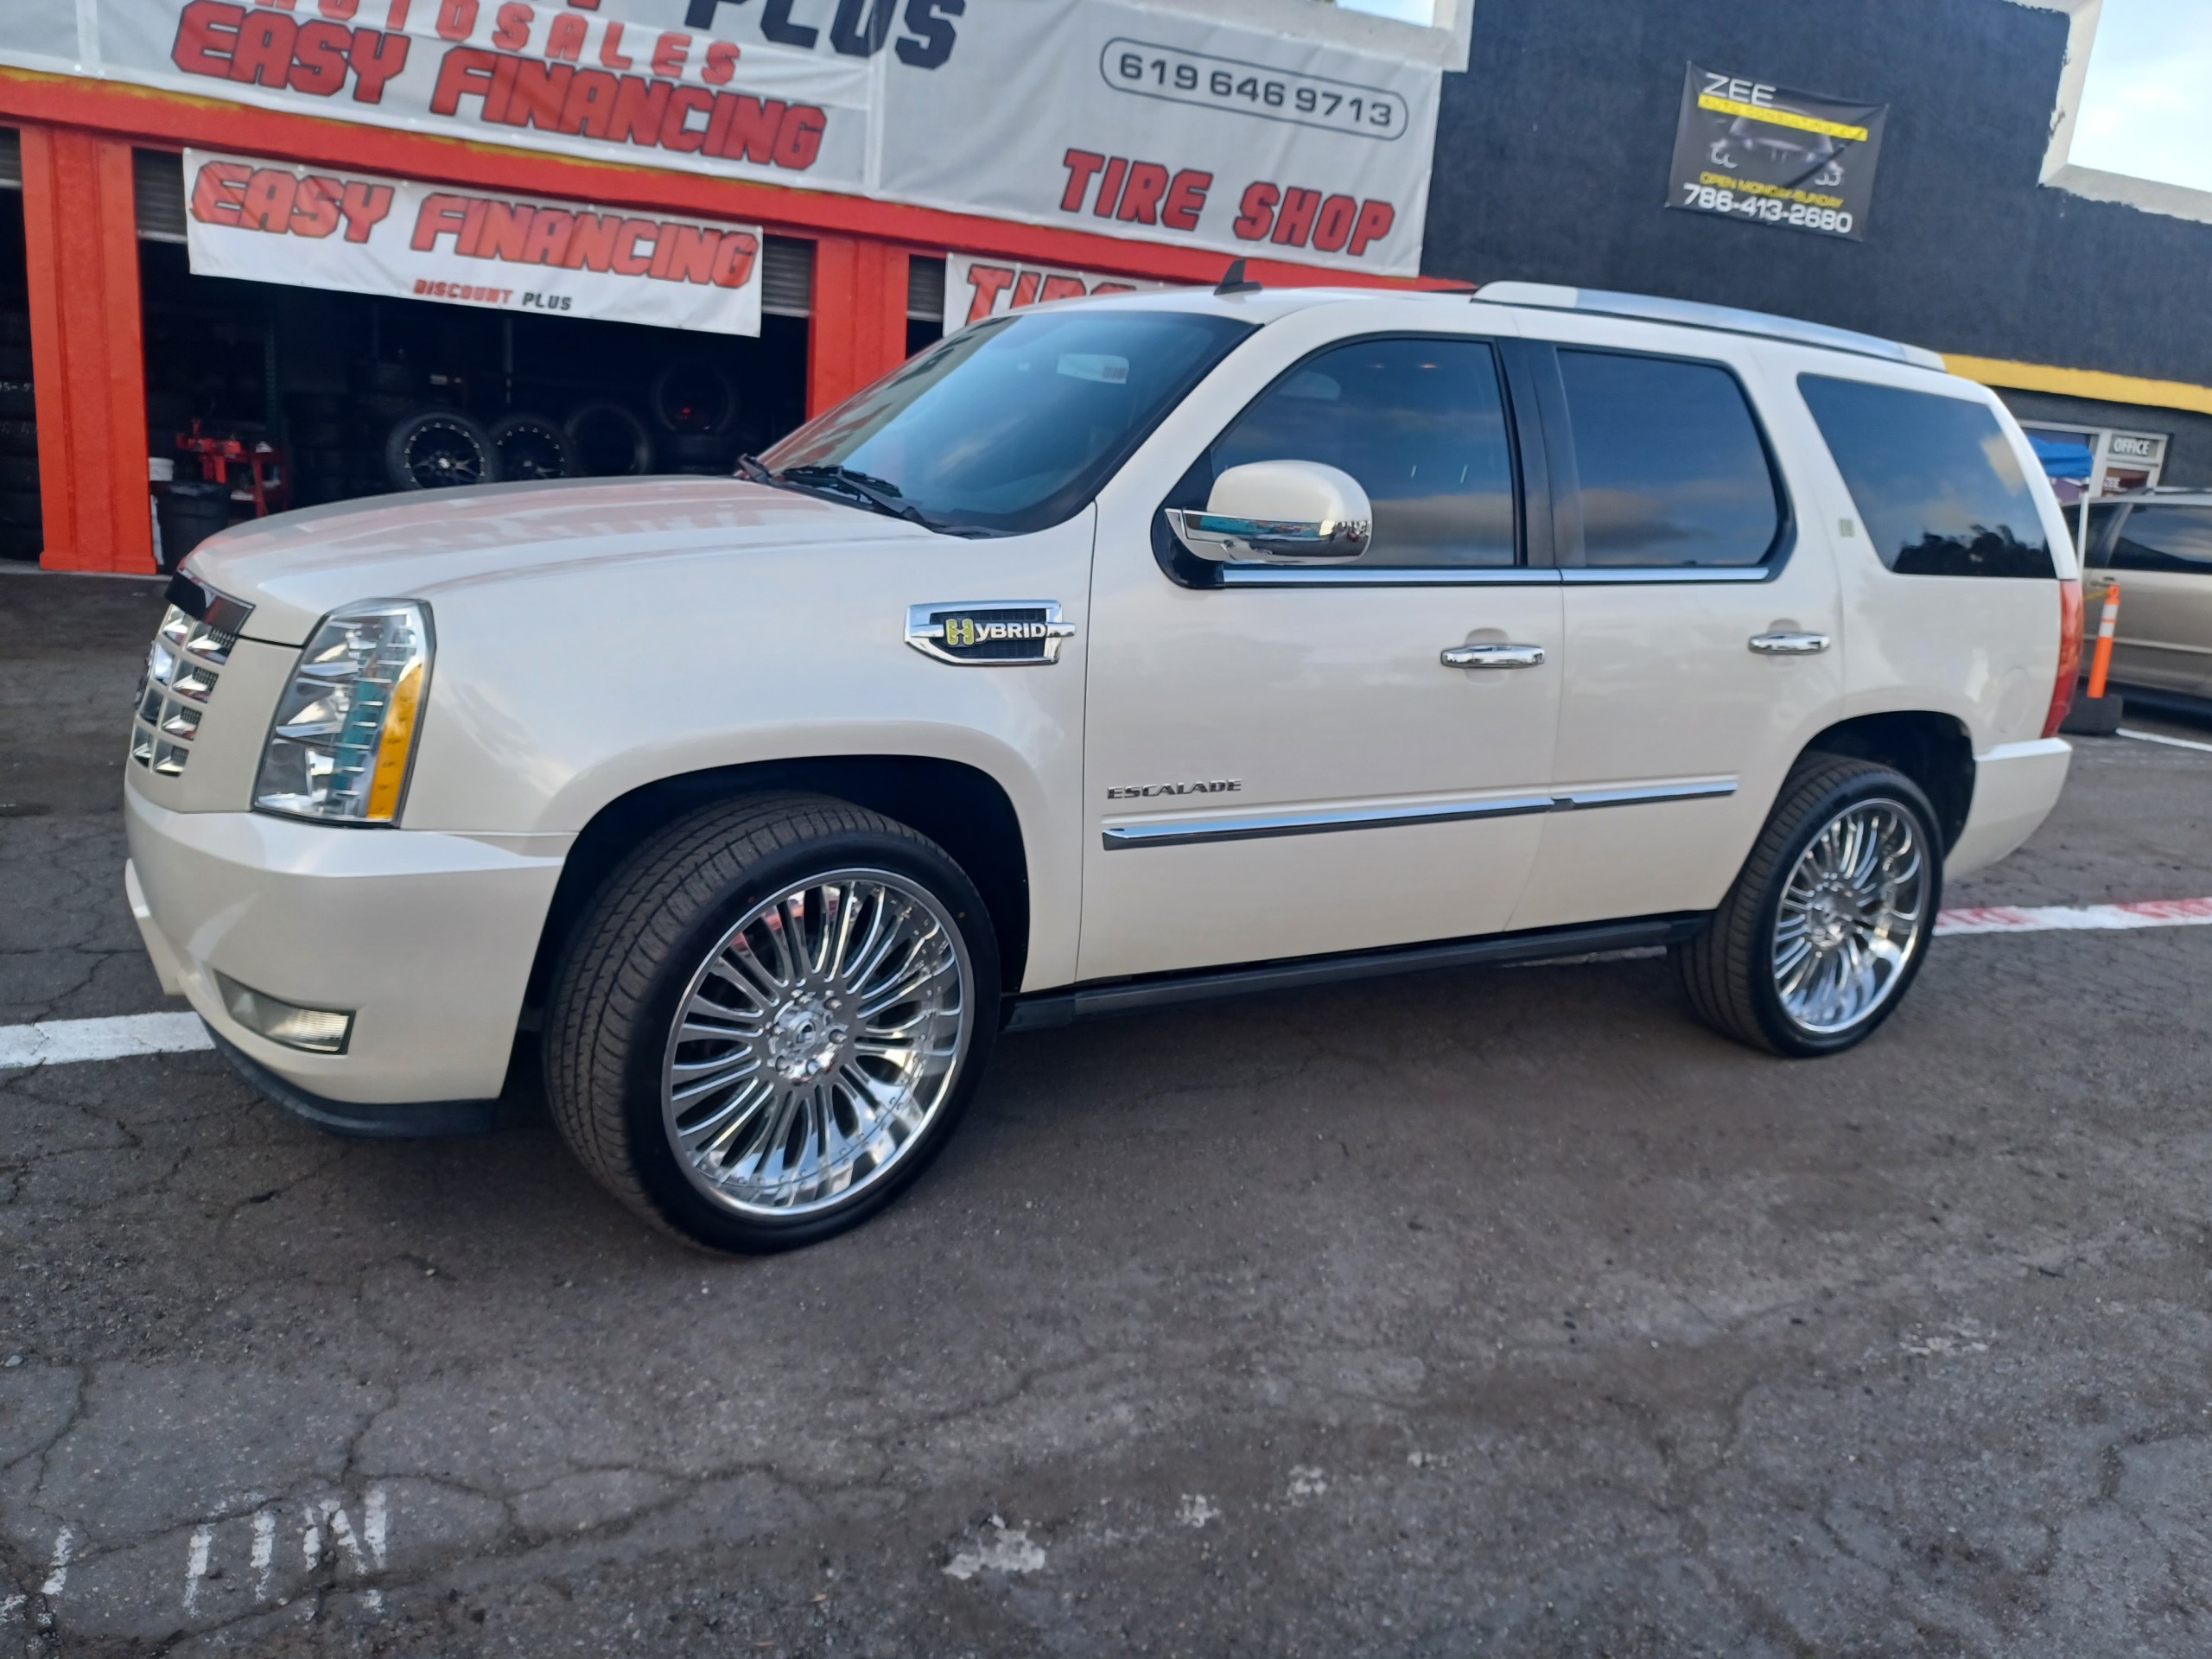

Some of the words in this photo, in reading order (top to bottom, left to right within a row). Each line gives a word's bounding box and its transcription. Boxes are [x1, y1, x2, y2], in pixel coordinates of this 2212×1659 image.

[255, 0, 741, 85] TOSALES
[171, 0, 411, 105] EASY
[429, 46, 827, 170] FINANCING
[1120, 53, 1198, 91] 619
[1210, 71, 1286, 108] 646
[1295, 87, 1391, 126] 9713
[1703, 72, 1777, 107] ZEE
[191, 160, 395, 244] EASY
[410, 192, 759, 289] FINANCING
[1060, 148, 1213, 231] TIRE
[1232, 181, 1395, 256] SHOP
[1683, 182, 1853, 233] 786-413-2680
[414, 279, 514, 303] DISCOUNT
[522, 291, 573, 311] PLUS
[965, 264, 1137, 327] TI
[2113, 437, 2150, 455] OFFICE
[1107, 779, 1242, 800] ESCALADE
